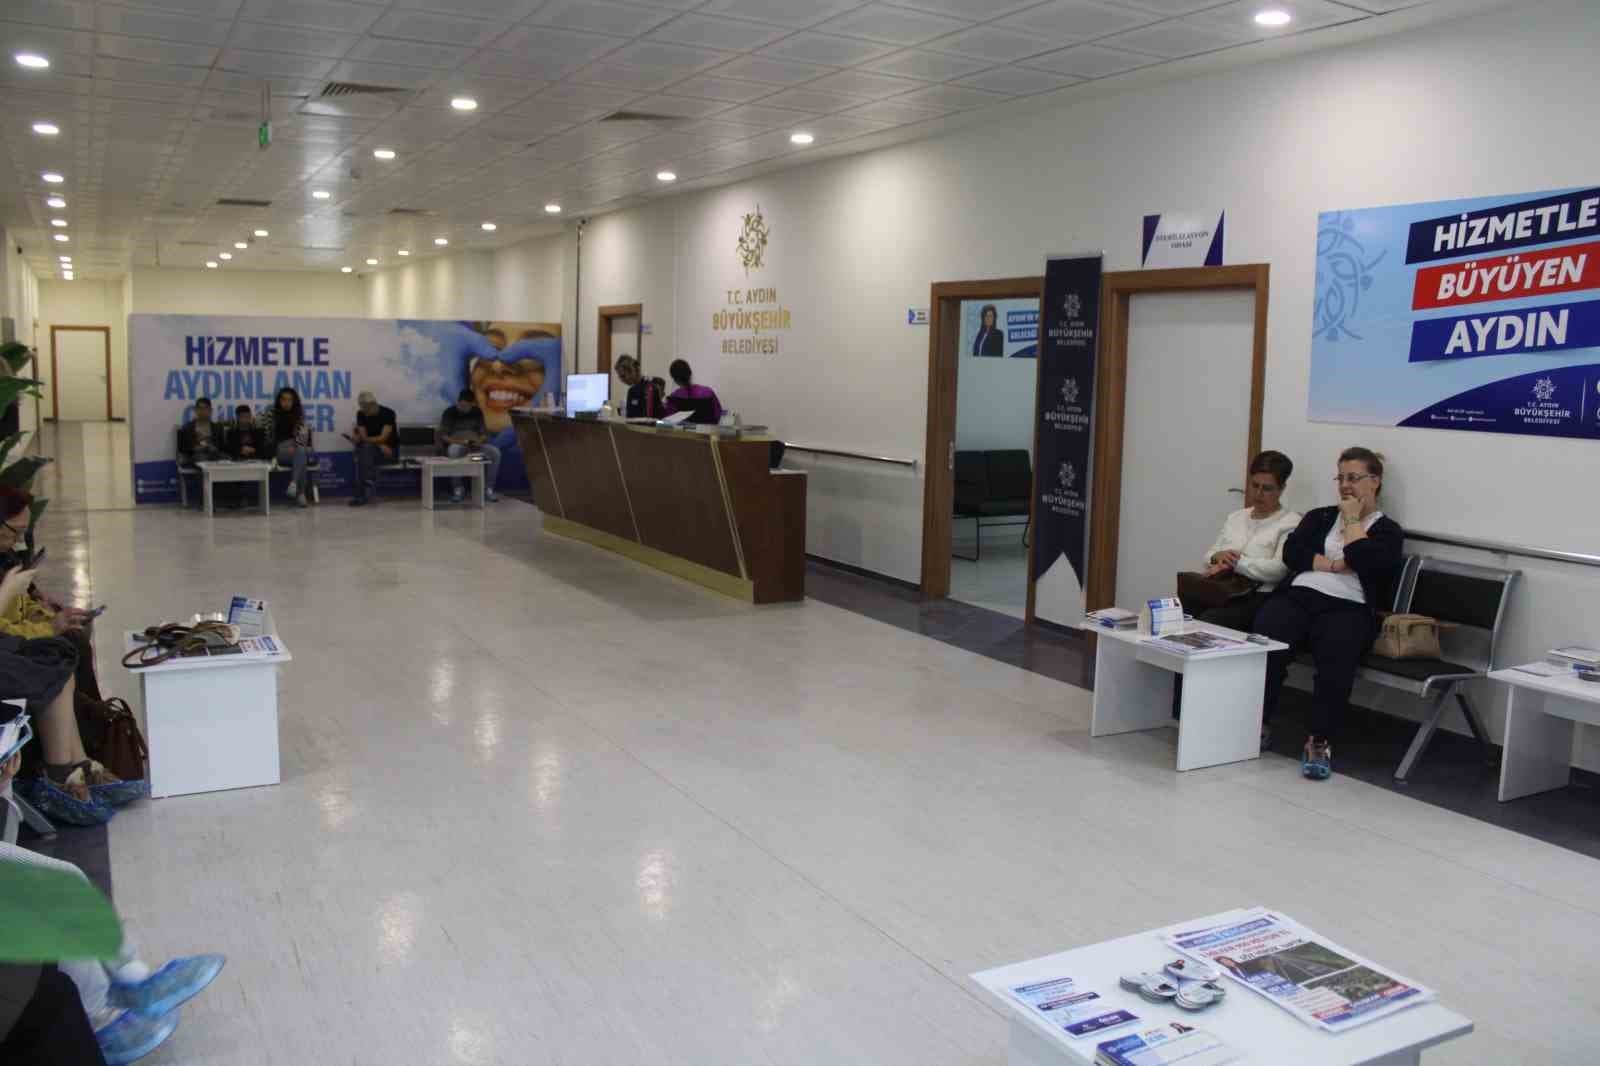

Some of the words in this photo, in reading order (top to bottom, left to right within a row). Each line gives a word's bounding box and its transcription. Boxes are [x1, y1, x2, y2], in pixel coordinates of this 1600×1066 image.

[1433, 196, 1600, 253] HİZMETLE
[1437, 254, 1587, 300] BÜYÜYEN
[746, 287, 777, 305] AYDIN
[712, 304, 791, 336] BÜYÜKŞEHİR
[1444, 309, 1569, 355] AYDIN
[164, 370, 352, 400] AYDINLANAN
[1514, 407, 1571, 418] BÜYÜKŞEHİR
